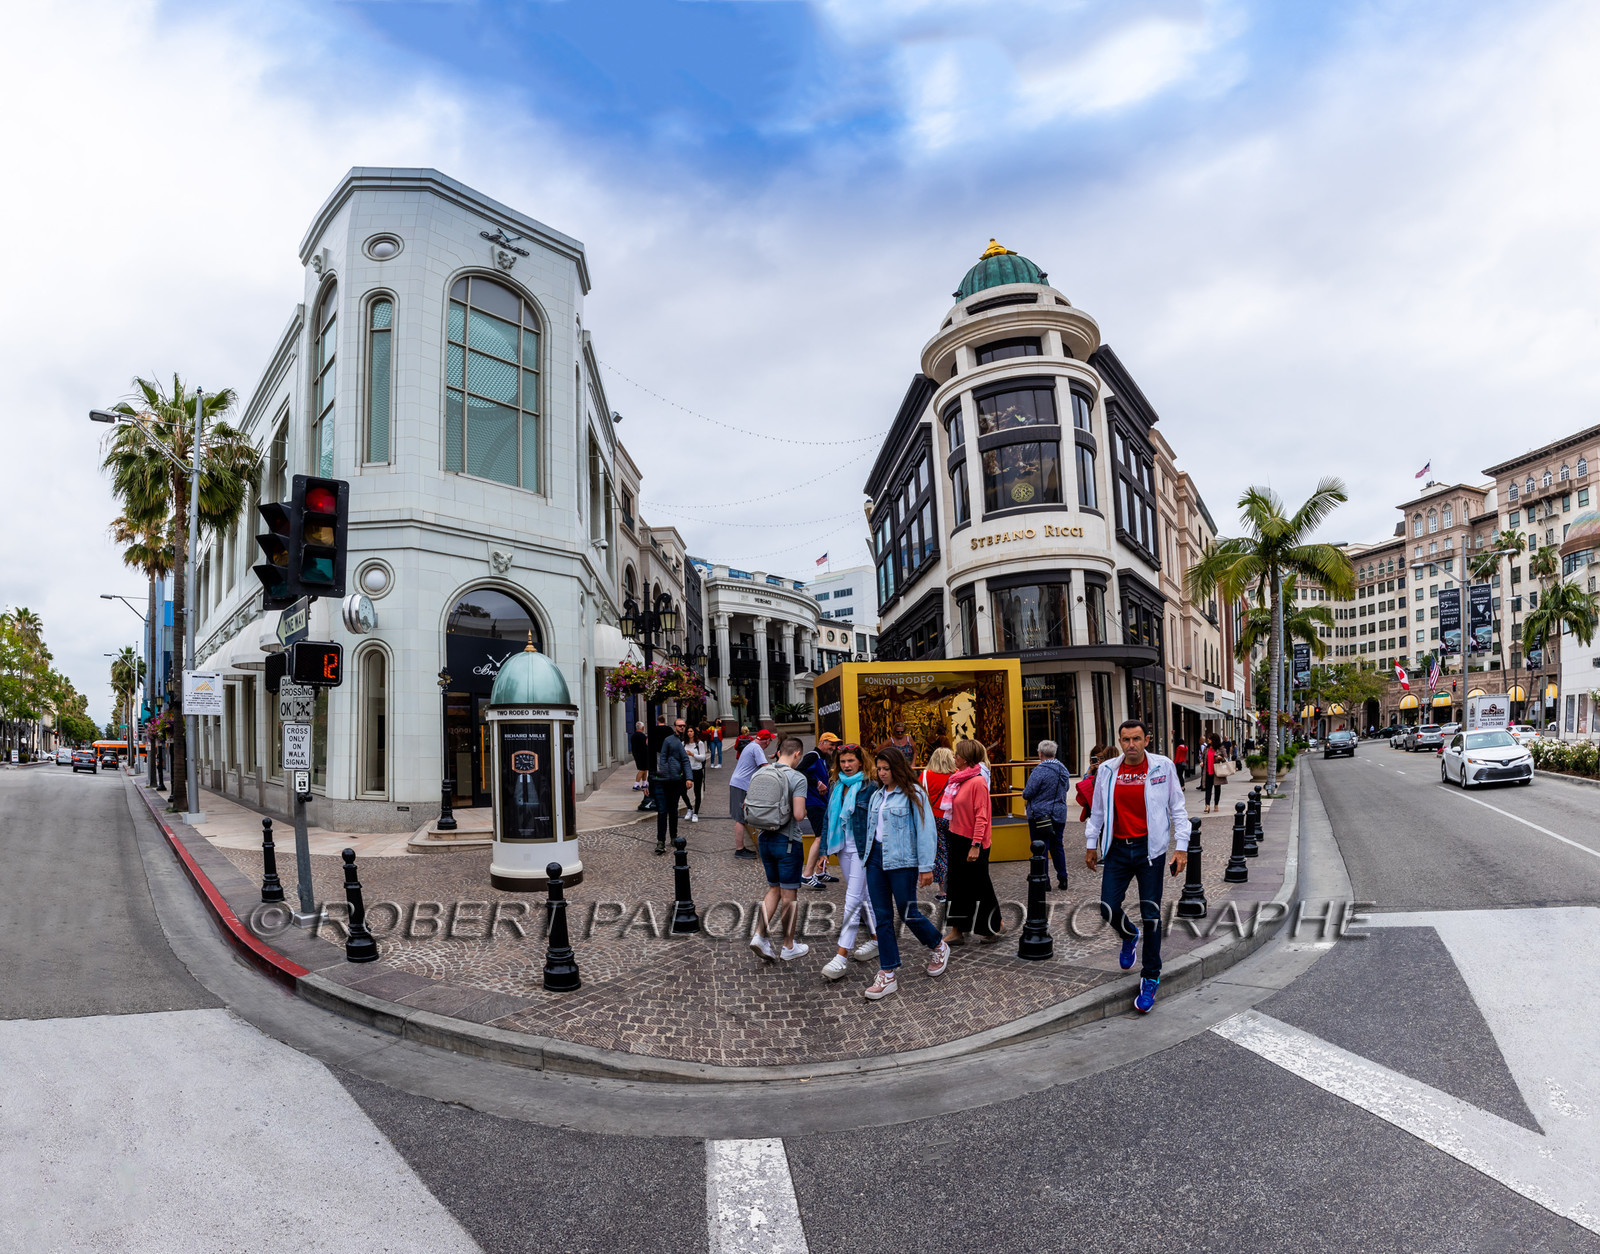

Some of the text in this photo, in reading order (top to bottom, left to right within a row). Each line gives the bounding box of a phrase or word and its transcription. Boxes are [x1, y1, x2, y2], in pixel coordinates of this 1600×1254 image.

[970, 524, 1084, 550] STEFANO RICCI
[284, 611, 304, 635] ONE WAY
[324, 653, 338, 678] 12
[864, 674, 935, 686] #ONLYONRODEO
[280, 687, 313, 697] CROSSING
[280, 702, 292, 716] OK
[286, 727, 309, 735] CROSS
[285, 758, 308, 766] SIGNAL
